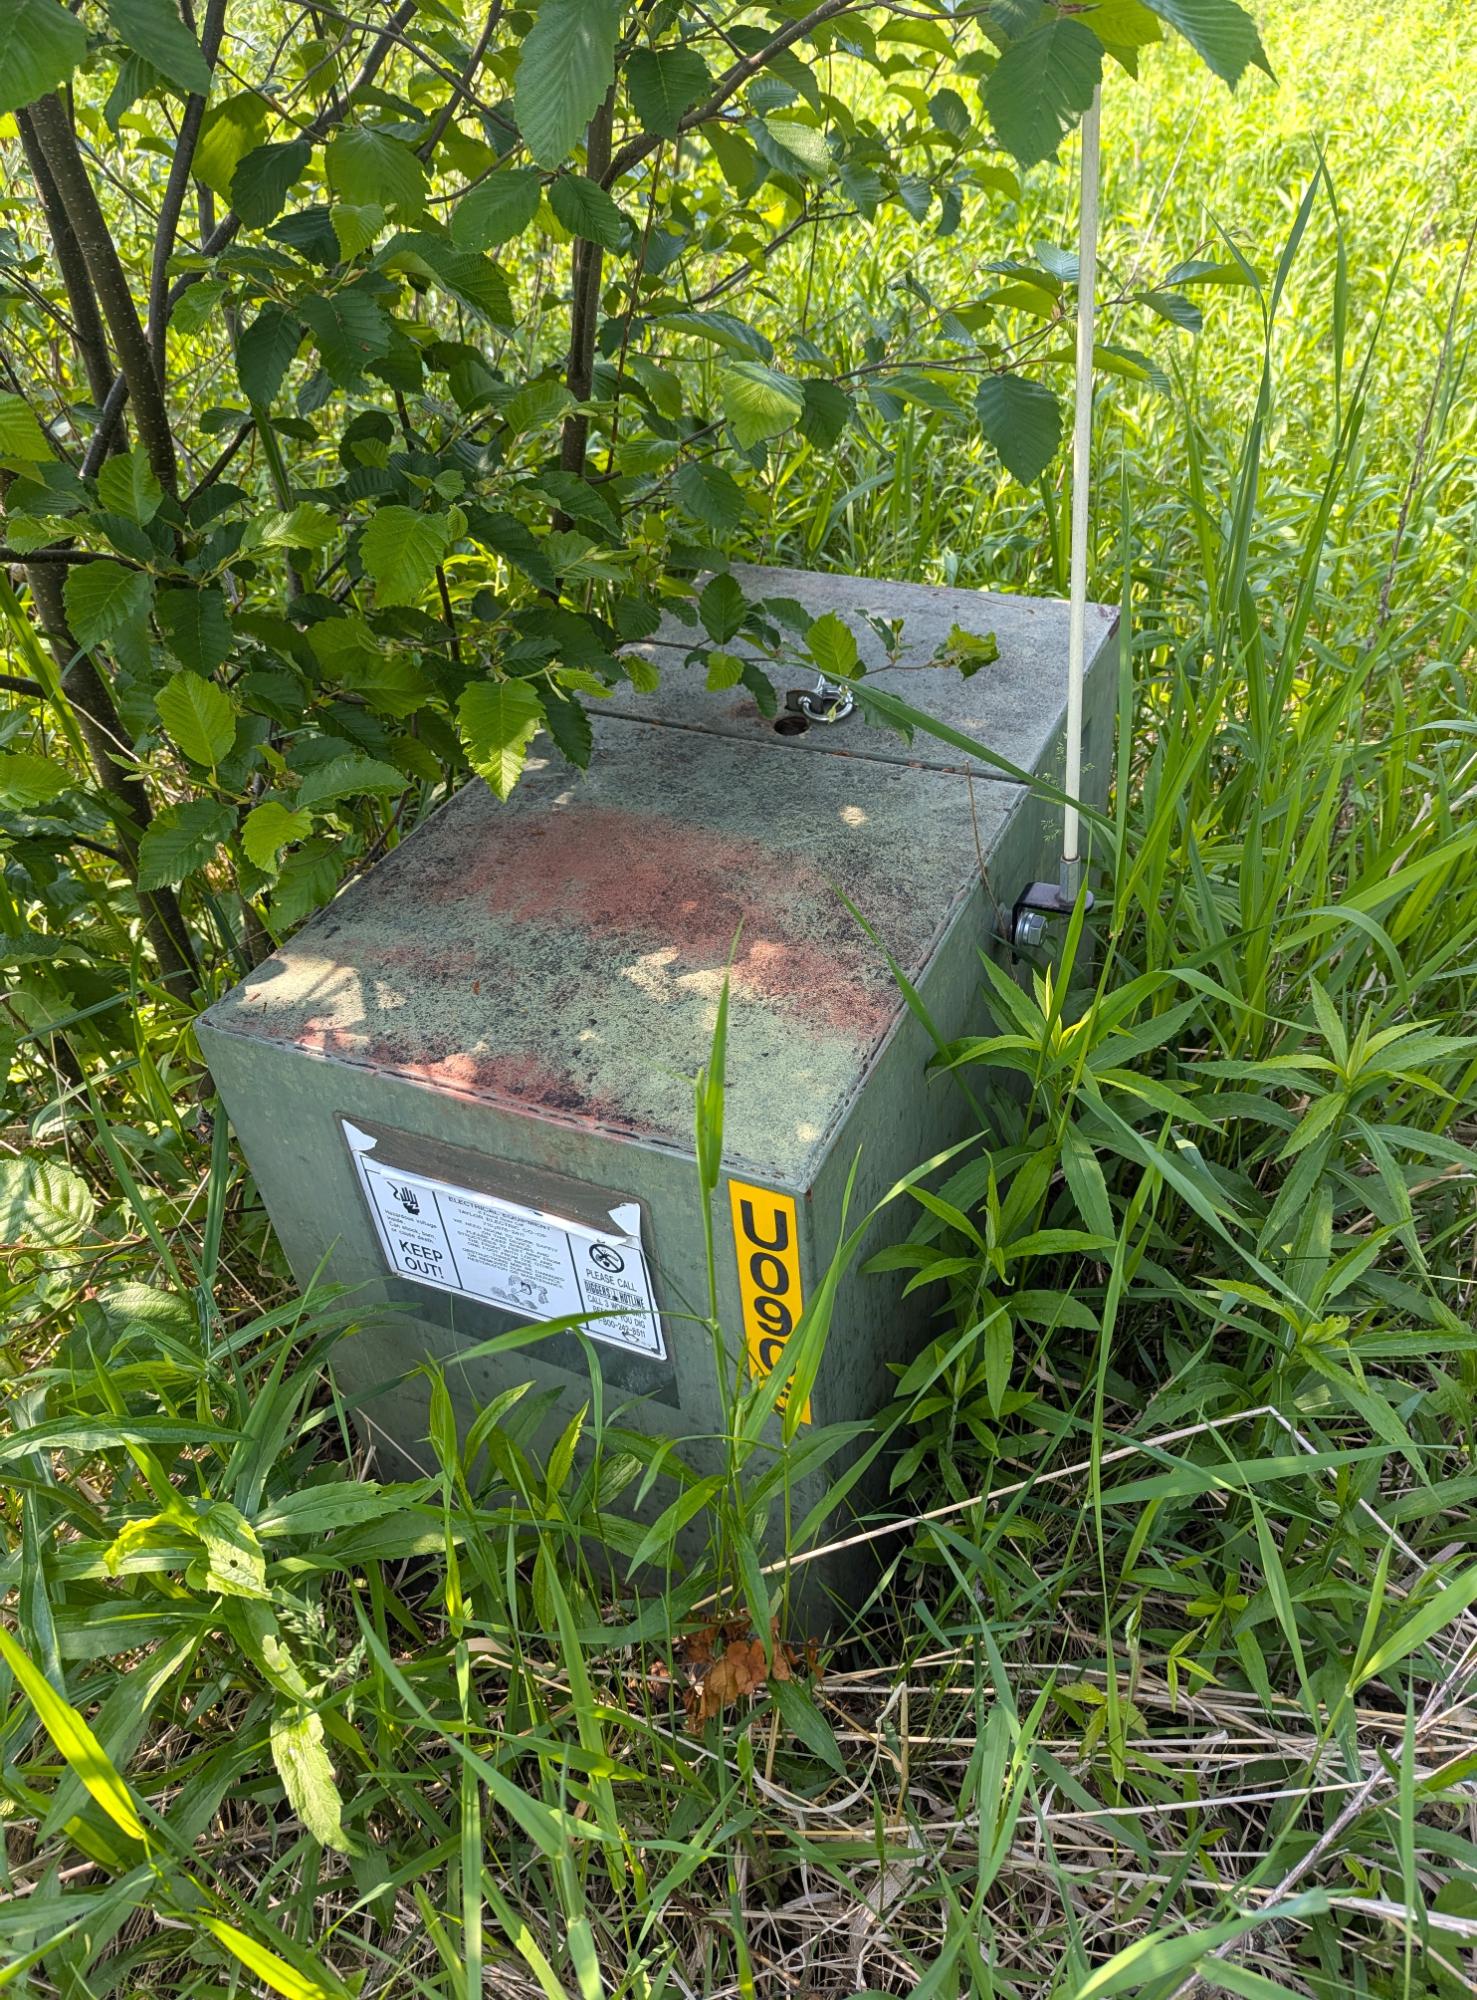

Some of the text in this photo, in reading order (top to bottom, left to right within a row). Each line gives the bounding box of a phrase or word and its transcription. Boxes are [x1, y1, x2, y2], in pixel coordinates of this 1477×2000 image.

[399, 1239, 443, 1262] KEEP
[405, 1257, 444, 1279] OUT!
[586, 1268, 637, 1292] PLEASE CALL
[584, 1280, 645, 1309] DIGGERS HOTLINE
[587, 1294, 603, 1306] CALL
